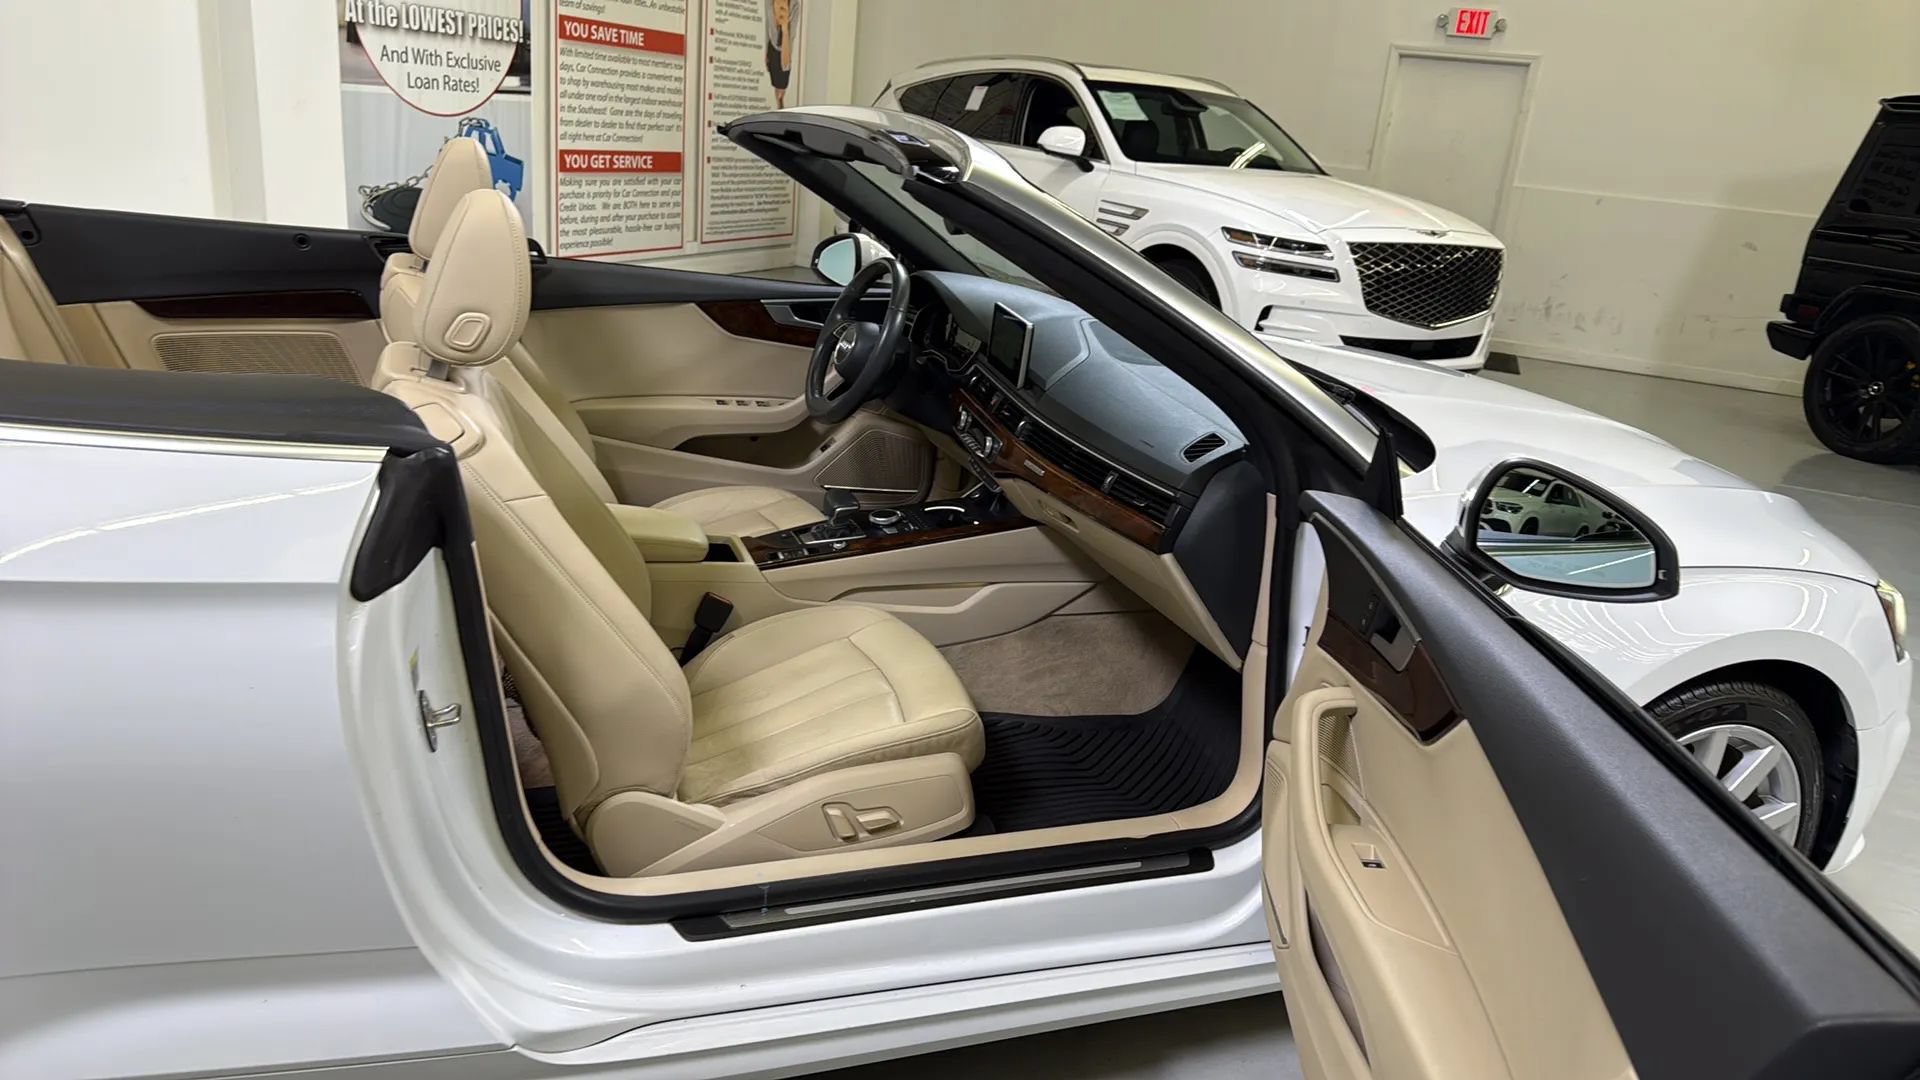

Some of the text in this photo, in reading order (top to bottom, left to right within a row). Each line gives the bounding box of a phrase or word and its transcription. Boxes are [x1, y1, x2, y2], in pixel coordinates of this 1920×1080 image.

[345, 0, 524, 43] At the LOWEST PRICES!
[1456, 10, 1490, 35] EXIT
[563, 21, 645, 47] YOU SAVE TIME
[380, 45, 501, 73] And With Exclusive
[560, 47, 573, 57] With
[576, 63, 586, 73] Car
[587, 64, 618, 76] Connection
[620, 68, 641, 80] provides
[407, 72, 480, 93] Loan Rates!
[567, 78, 581, 88] shop
[582, 79, 589, 89] by
[590, 80, 625, 93] warehousing
[626, 82, 639, 91] most
[640, 83, 656, 93] makes
[656, 84, 666, 93] and
[560, 90, 568, 99] all
[568, 91, 585, 100] under
[596, 92, 608, 102] roof
[614, 94, 623, 103] the
[624, 95, 640, 106] largest
[567, 104, 577, 113] the
[609, 106, 623, 116] Gone
[624, 109, 634, 117] are
[634, 109, 643, 117] the
[644, 110, 655, 120] days
[560, 117, 573, 126] from
[575, 118, 592, 127] dealer
[601, 120, 617, 129] dealer
[625, 121, 635, 130] find
[636, 122, 646, 130] that
[647, 122, 664, 132] perfect
[568, 132, 581, 143] right
[582, 133, 594, 142] here
[602, 133, 611, 142] Car
[612, 134, 643, 143] Connection!
[564, 154, 653, 169] YOU GET SERVICE
[560, 177, 583, 188] Making
[584, 178, 598, 187] sure
[599, 178, 611, 188] you
[612, 178, 621, 186] are
[623, 177, 646, 186] satisfied
[647, 177, 659, 186] with
[660, 178, 672, 187] your
[560, 190, 585, 200] purchase
[592, 190, 612, 200] priority
[613, 189, 621, 199] for
[621, 189, 631, 198] Car
[632, 189, 659, 198] Connection
[660, 188, 670, 197] and
[671, 189, 681, 199] your
[560, 203, 577, 212] Credit
[578, 202, 597, 211] Union.
[602, 202, 611, 210] We
[612, 202, 621, 210] are
[623, 200, 637, 210] BOTH
[639, 200, 650, 209] here
[658, 201, 671, 209] serve
[672, 201, 681, 210] you
[560, 214, 579, 225] before,
[580, 214, 599, 225] during
[600, 213, 611, 222] and
[612, 212, 624, 222] after
[625, 213, 637, 223] your
[638, 212, 659, 222] purchase
[560, 227, 570, 237] the
[571, 226, 587, 236] most
[625, 223, 652, 234] hassle-free
[653, 223, 662, 231] car
[663, 222, 681, 233] buying
[560, 238, 614, 250] experience possible!
